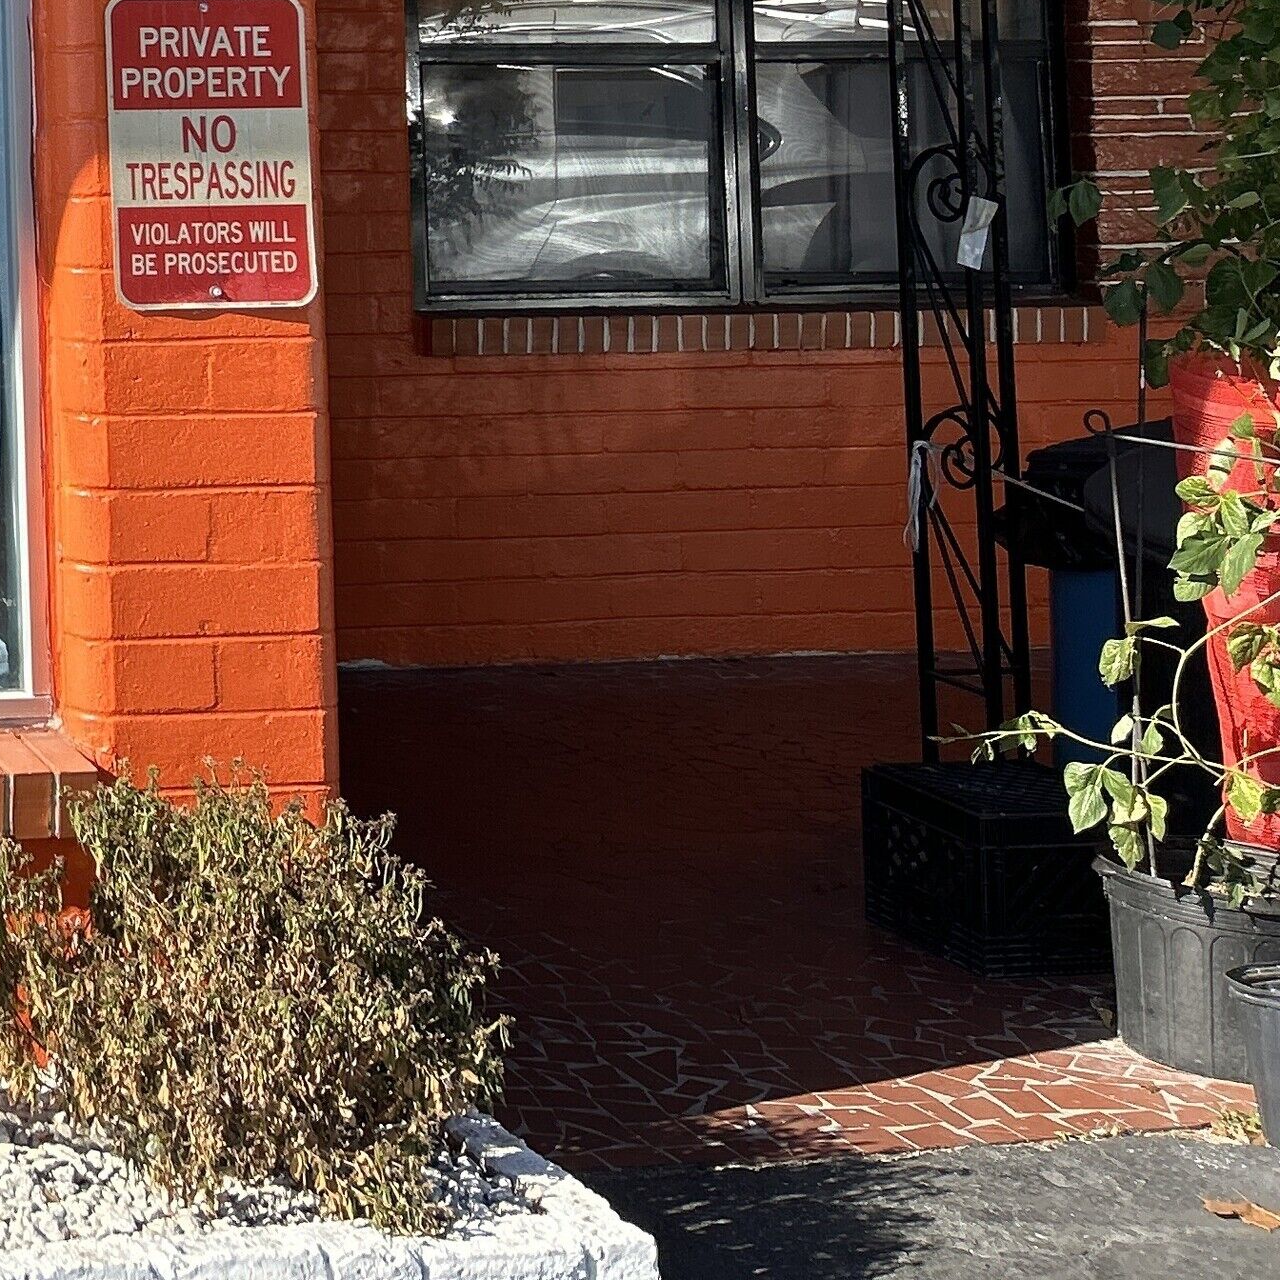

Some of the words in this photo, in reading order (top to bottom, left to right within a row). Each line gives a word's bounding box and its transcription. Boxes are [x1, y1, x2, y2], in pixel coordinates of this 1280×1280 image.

[139, 26, 272, 58] PRIVATE
[121, 66, 290, 99] PROPERTY
[182, 115, 236, 153] NO
[126, 160, 295, 200] TRESPASSING
[131, 222, 243, 245] VIOLATORS
[248, 221, 296, 243] WILL
[132, 254, 157, 276] BE
[165, 251, 298, 275] PROSECUTED
